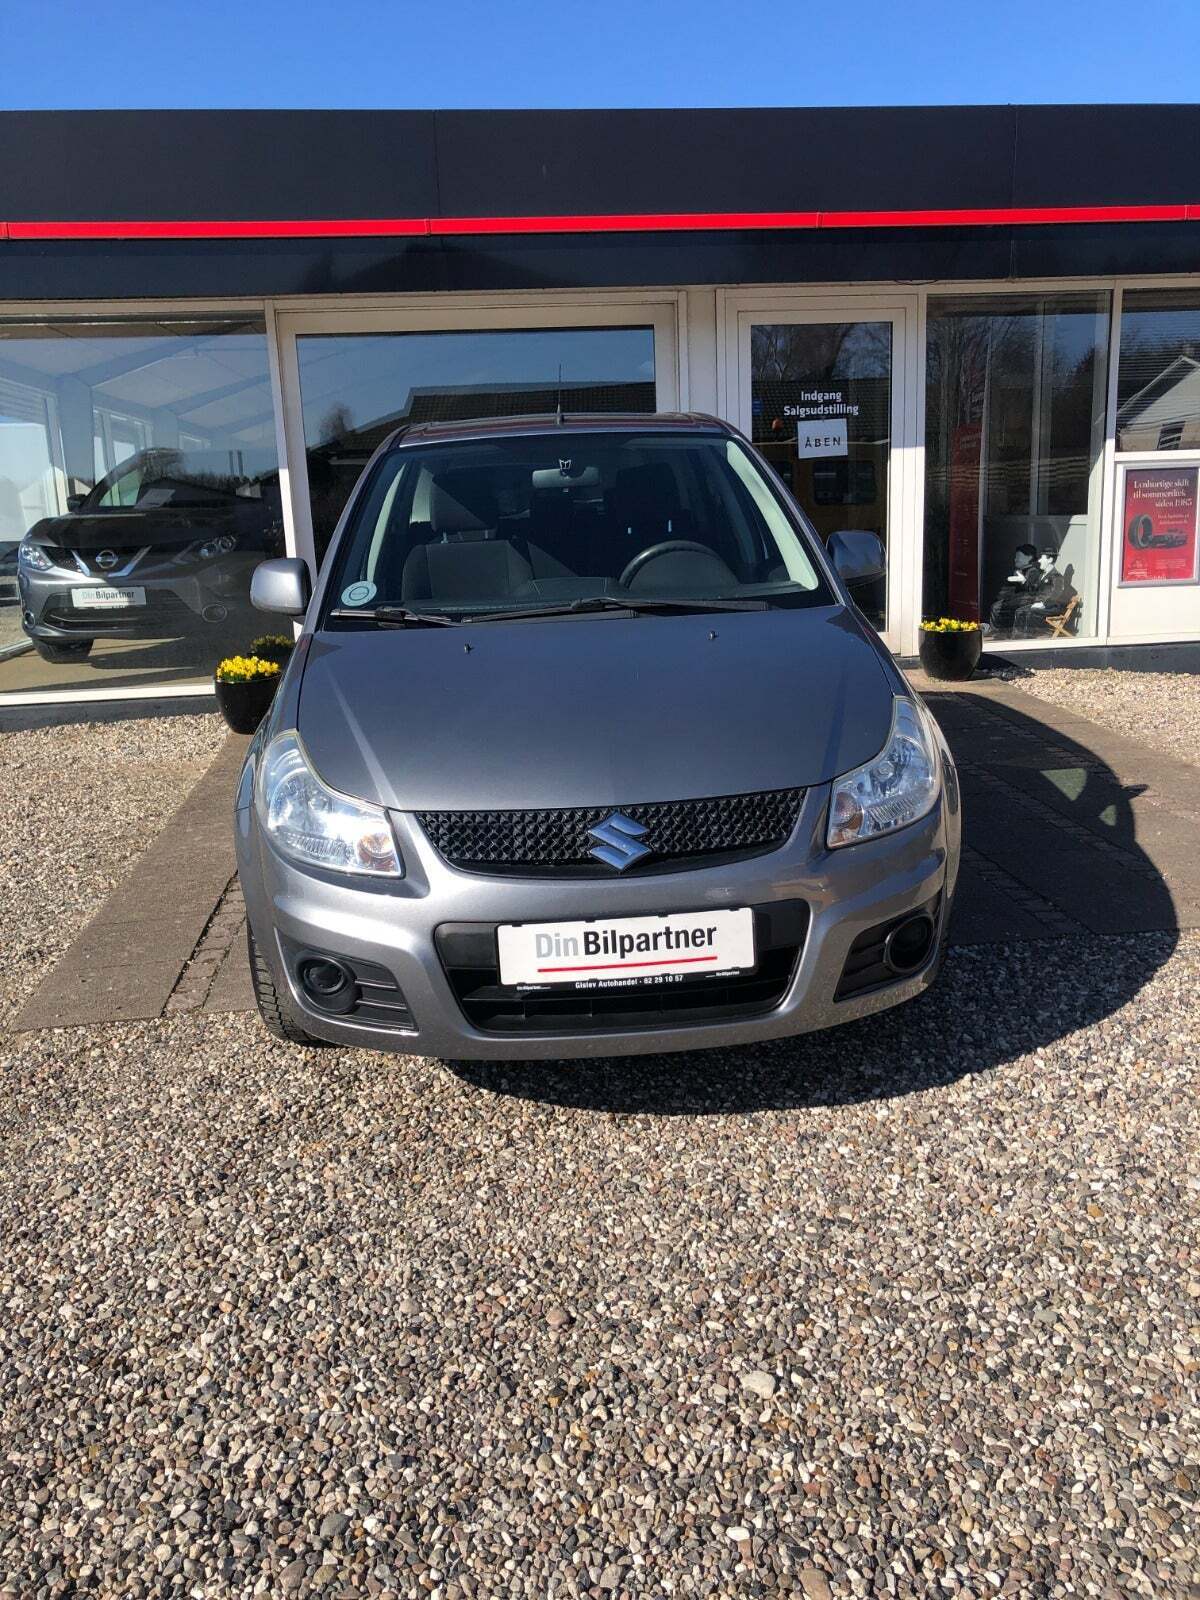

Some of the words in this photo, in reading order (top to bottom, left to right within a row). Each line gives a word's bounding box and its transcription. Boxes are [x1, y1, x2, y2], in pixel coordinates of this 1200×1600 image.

[801, 390, 842, 402] Indgang
[783, 403, 859, 418] Salgsudstilling
[804, 436, 841, 449] ÅBEN
[598, 978, 638, 988] Autohandel
[664, 975, 673, 983] 10
